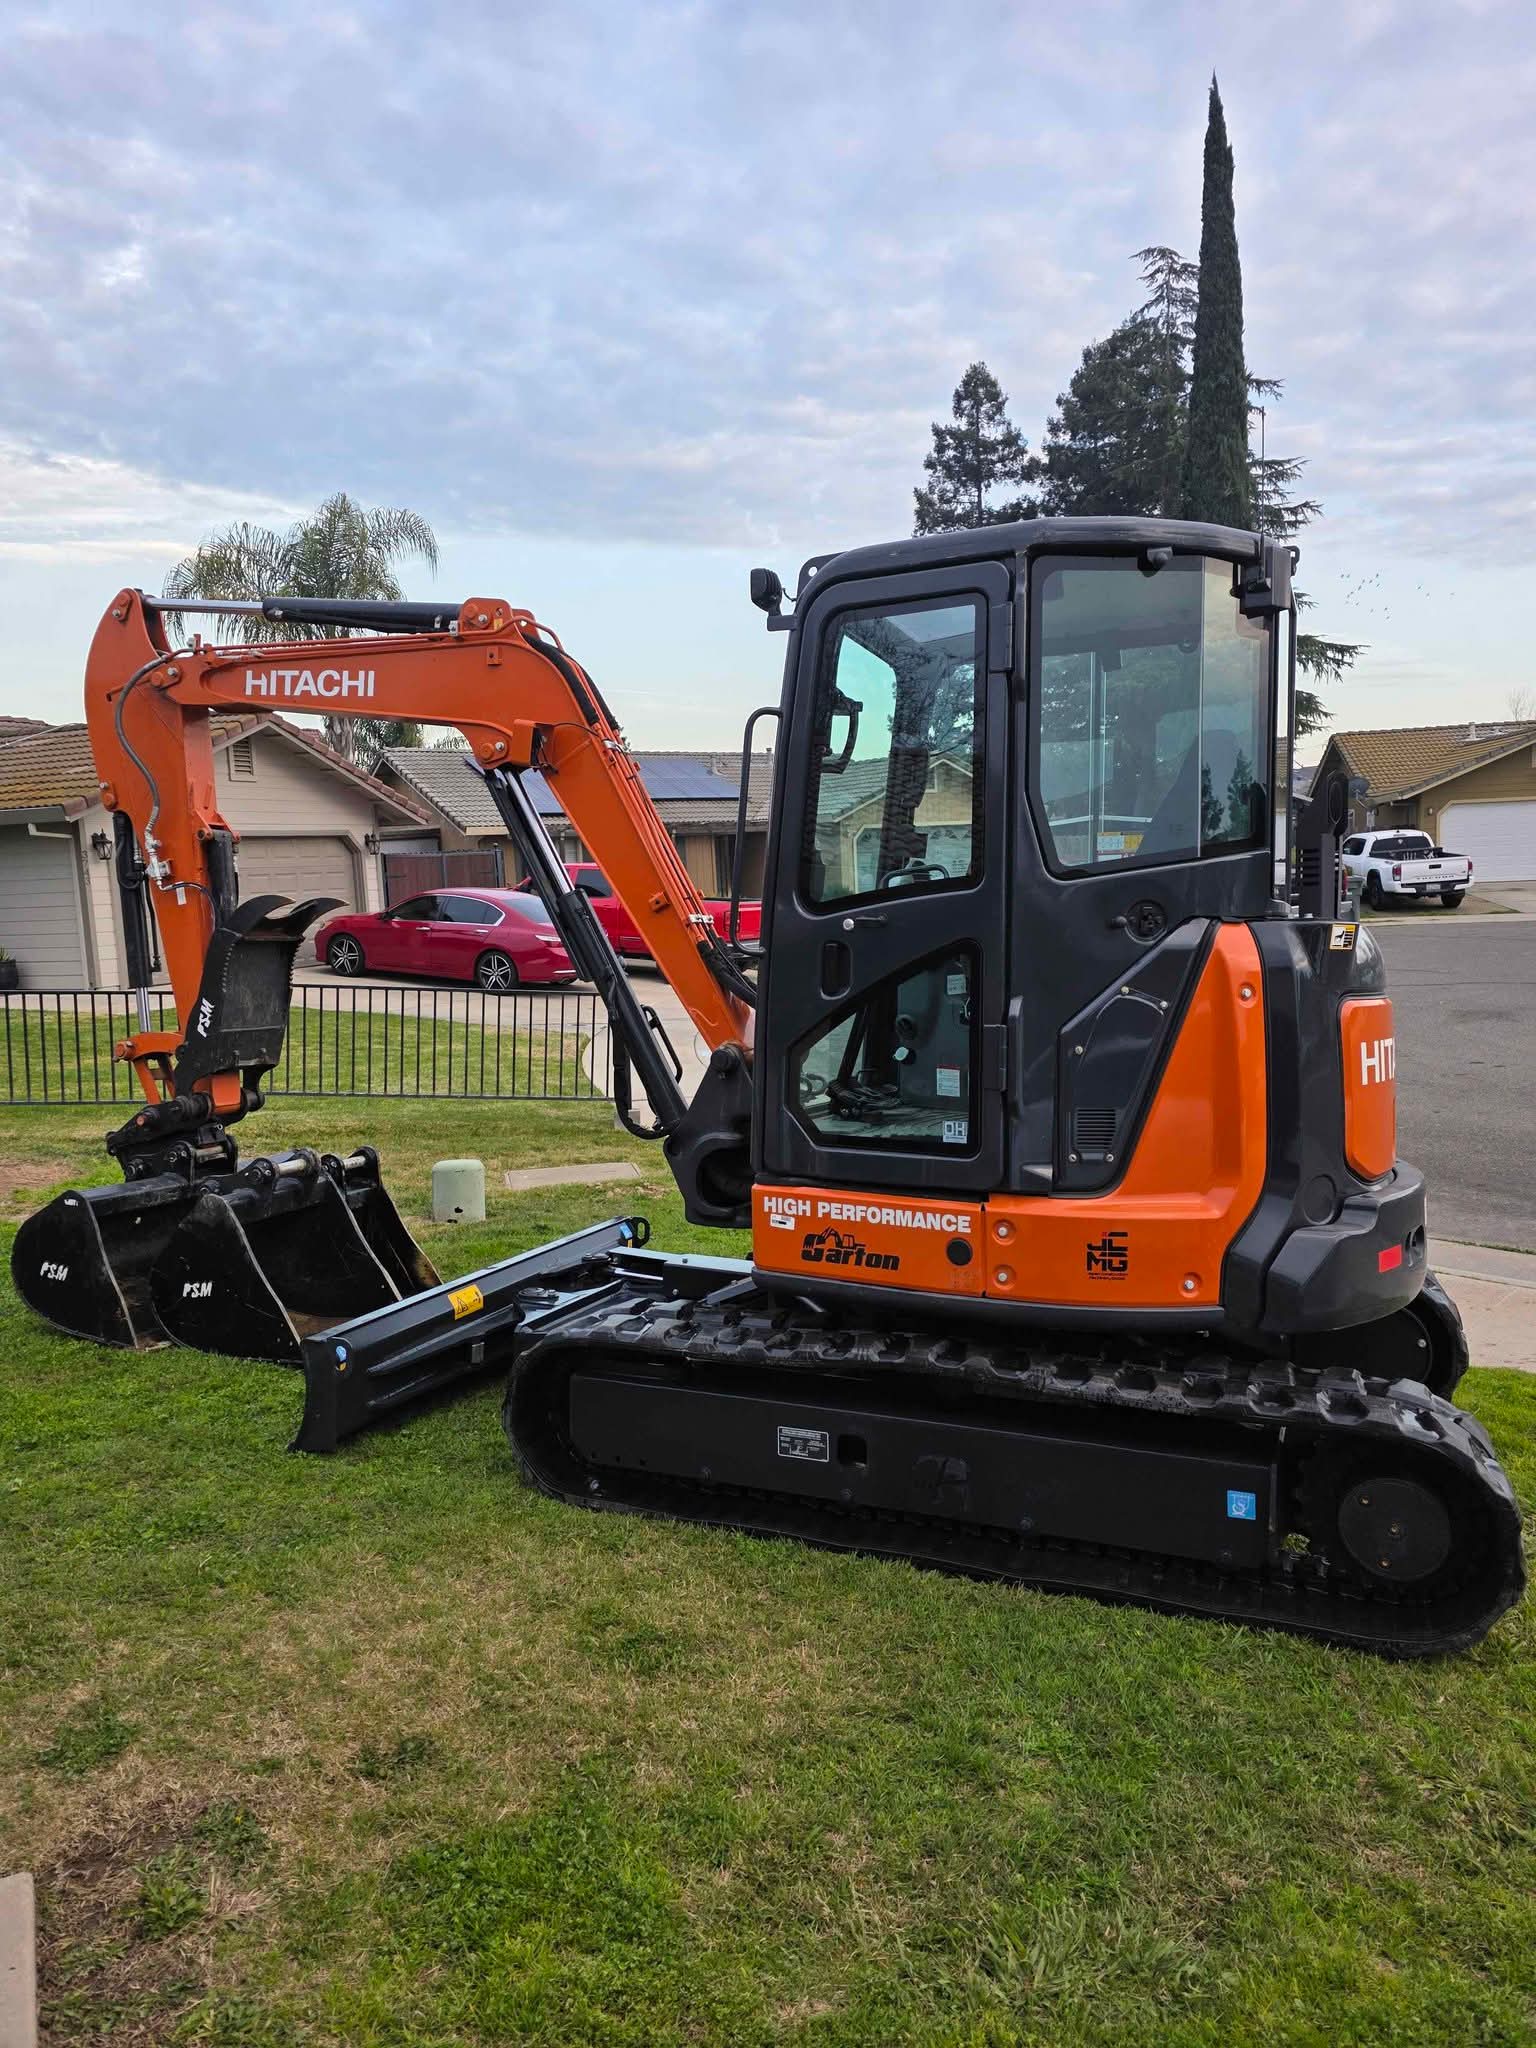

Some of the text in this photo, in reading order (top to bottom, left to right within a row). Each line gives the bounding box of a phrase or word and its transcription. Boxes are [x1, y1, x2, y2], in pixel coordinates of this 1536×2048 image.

[245, 669, 375, 697] HITACHI
[197, 997, 215, 1038] PSM
[1360, 1037, 1395, 1086] HIT
[763, 1196, 811, 1217] HIGH
[817, 1201, 972, 1233] PERFORMANCE
[40, 1262, 69, 1282] PSM
[182, 1281, 213, 1298] PSM
